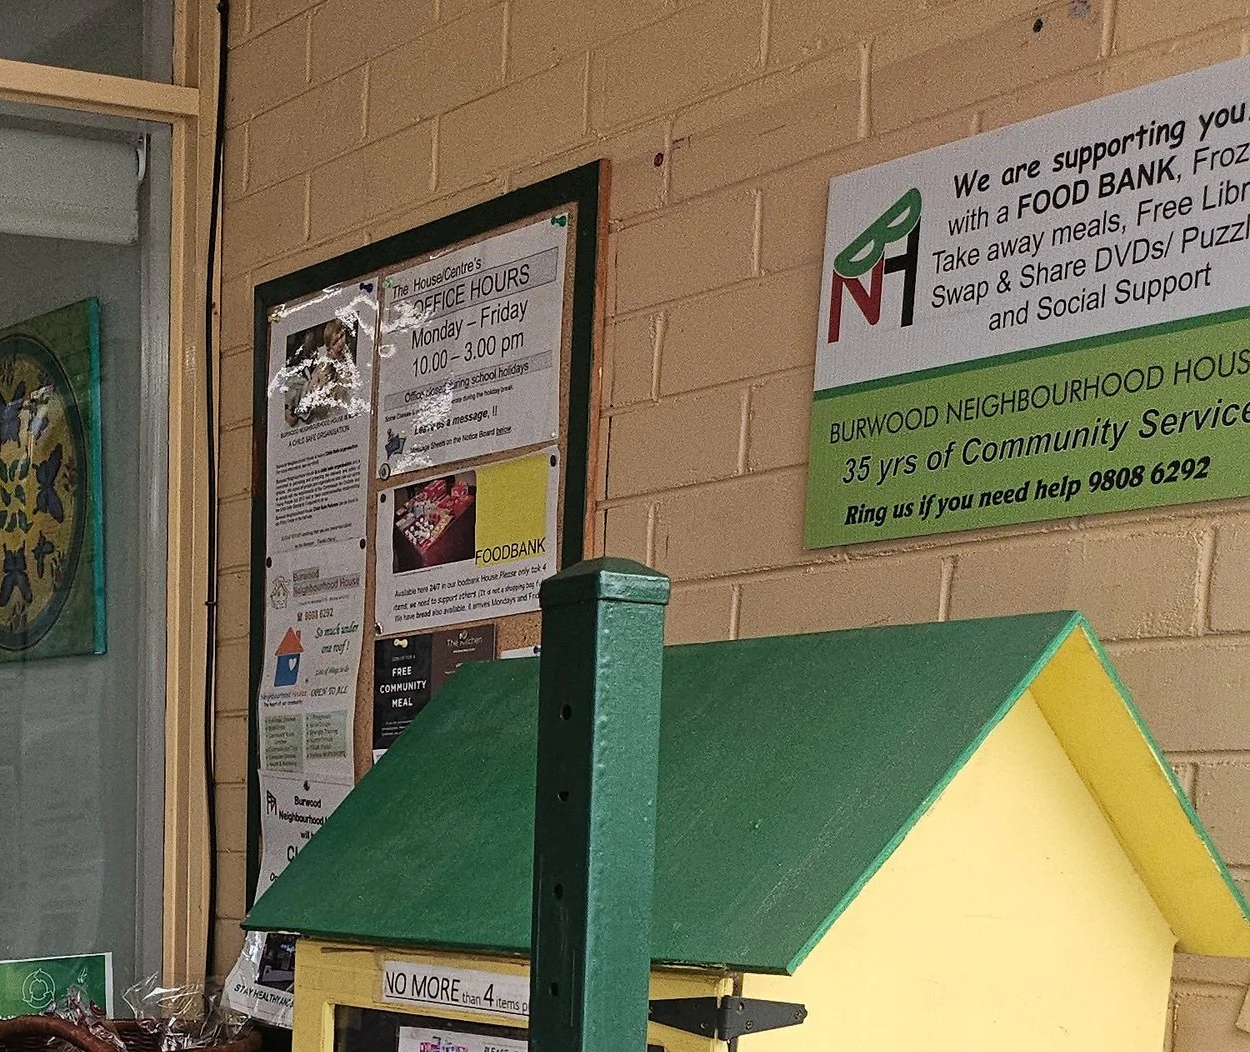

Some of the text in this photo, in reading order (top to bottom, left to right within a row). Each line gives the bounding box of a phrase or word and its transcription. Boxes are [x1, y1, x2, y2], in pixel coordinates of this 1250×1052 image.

[954, 103, 1250, 199] We are supporting you
[949, 144, 1250, 237] with a FOOD BANK, Froz
[933, 181, 1250, 275] Take away meals, Free Libr
[932, 215, 1250, 309] Swap & Share DVDs/ Puzzl
[393, 284, 409, 299] The
[413, 263, 530, 315] OFFICE HOURS
[988, 263, 1212, 331] and Social Support
[411, 299, 529, 350] Monday Friday
[412, 331, 524, 377] 10.00 3.00 pm
[404, 390, 423, 403] Office
[471, 368, 497, 387] school
[499, 361, 529, 379] holidays
[830, 350, 1250, 444] BURWOOD NEIGHBOURHOOD HOUS
[843, 458, 870, 484] 35
[877, 450, 917, 487] yrs
[927, 442, 957, 469] of
[961, 416, 1129, 465] Community
[844, 456, 1212, 527] Ring us if you need help 9808 6292
[475, 537, 546, 565] FOODBANK
[542, 563, 547, 571] 4
[416, 609, 431, 618] bread
[380, 680, 427, 693] COMMUNITY
[392, 667, 412, 676] FREE
[392, 698, 413, 707] MEAL
[279, 810, 323, 825] Neighbourhood
[294, 796, 321, 808] Burwood
[234, 984, 253, 996] STAY
[254, 989, 280, 1005] HEALTHY
[386, 972, 406, 994] NO
[412, 974, 460, 1002] MORE
[462, 992, 481, 1006] than
[484, 984, 494, 1006] 4
[496, 996, 519, 1011] items
